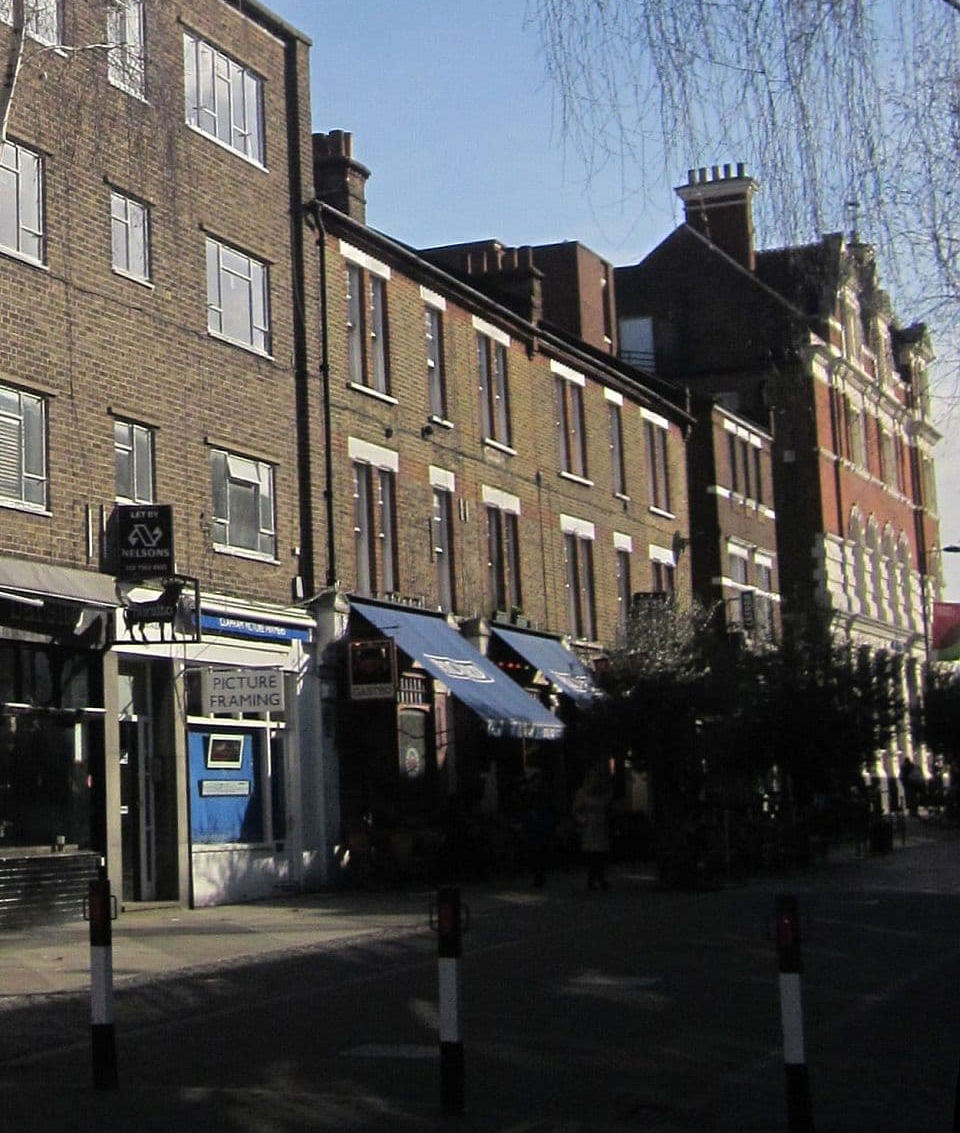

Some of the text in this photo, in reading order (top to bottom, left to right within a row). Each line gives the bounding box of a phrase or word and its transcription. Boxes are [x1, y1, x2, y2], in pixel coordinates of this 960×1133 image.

[121, 548, 170, 558] NELSONS
[213, 675, 277, 690] PICTURE
[210, 693, 280, 708] FRAMING
